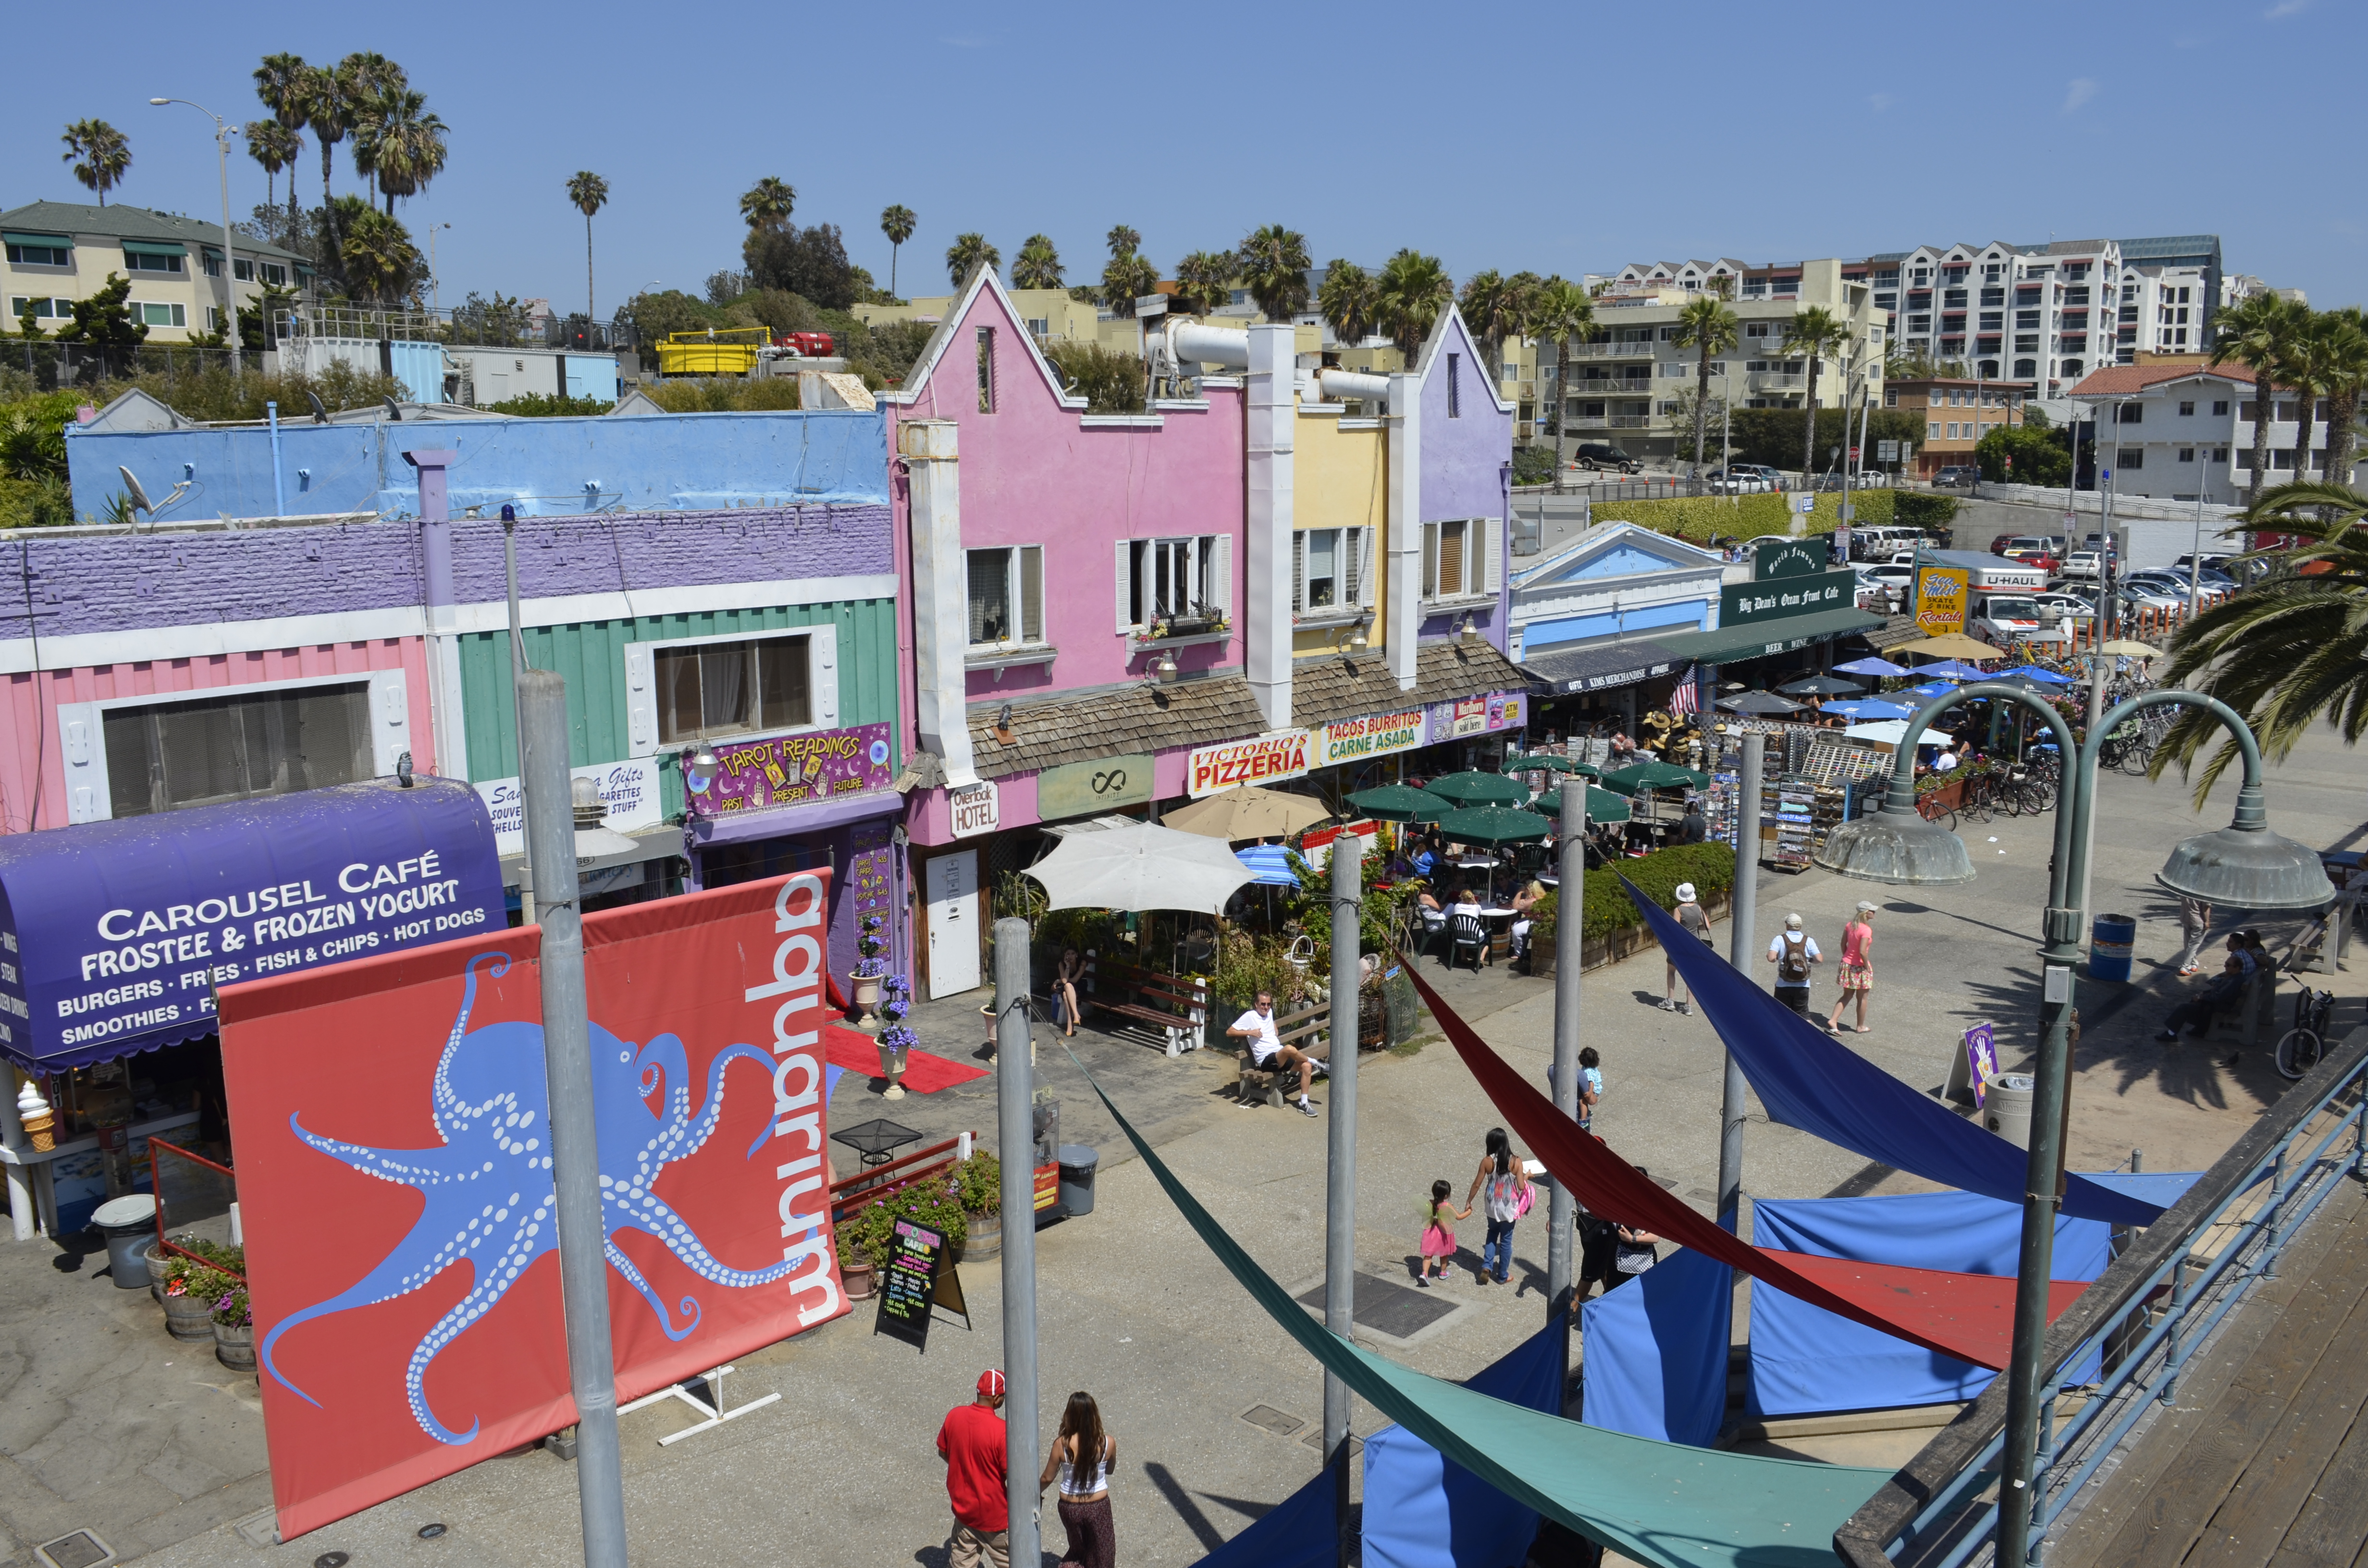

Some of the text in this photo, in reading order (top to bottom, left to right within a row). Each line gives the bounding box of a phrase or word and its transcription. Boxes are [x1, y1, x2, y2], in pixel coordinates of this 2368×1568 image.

[1768, 547, 1815, 574] World Famous
[1924, 573, 1955, 586] Sea
[1987, 576, 2037, 585] U-HAUL
[1739, 586, 1839, 613] Big Dean's Ocean Front Cafe
[1917, 610, 1962, 626] Rentals
[1765, 642, 1783, 654] BEER
[1791, 638, 1808, 649] WINE
[1815, 633, 1834, 643] FOOD
[1568, 663, 1669, 690] GIFTS KIMS MERCHANDISE APPAREL
[1458, 701, 1483, 716] Marlboro
[1505, 704, 1518, 712] ATM
[1327, 720, 1365, 741] TACOS
[1368, 710, 1422, 734] BURRITOS
[1459, 721, 1469, 733] sold
[1470, 720, 1480, 731] here
[1195, 734, 1308, 766] VICTORIO'S
[1329, 728, 1415, 760] CARNE ASADA
[720, 736, 860, 777] TAROT READINGS
[609, 767, 644, 791] Gifts
[1195, 747, 1305, 790] PIZZERIA
[599, 787, 641, 801] GARETTES
[722, 777, 863, 811] PAST PRESENT FUTURE
[954, 785, 992, 806] Overlook
[1096, 792, 1120, 801] INFINITY
[956, 802, 997, 831] HOTEL
[855, 858, 872, 869] TAROT
[856, 867, 874, 877] CARDS
[98, 849, 441, 942] CAROUSEL CAFÉ
[856, 890, 875, 902] PSYCHIC
[81, 880, 459, 981] FROSTEE & FROZEN YOGURT
[3, 931, 17, 953] WINGS
[58, 908, 485, 1017] BURGERS FRIES FISH & CHIPS HOT DOGS
[1, 963, 17, 984] STEAK
[11, 996, 28, 1019] DRINKS
[62, 1004, 179, 1044] SMOOTHIES
[1970, 1030, 1989, 1043] PSYCHIC
[744, 874, 841, 1329] aquarium
[1040, 1170, 1058, 1180] Monica
[896, 1222, 939, 1247] CAROUSEL
[904, 1237, 924, 1253] CAFE
[890, 1284, 902, 1292] Latte
[891, 1278, 904, 1286] Churros
[889, 1292, 905, 1301] Espresso
[895, 1302, 906, 1310] mocha
[887, 1306, 900, 1315] Coffee
